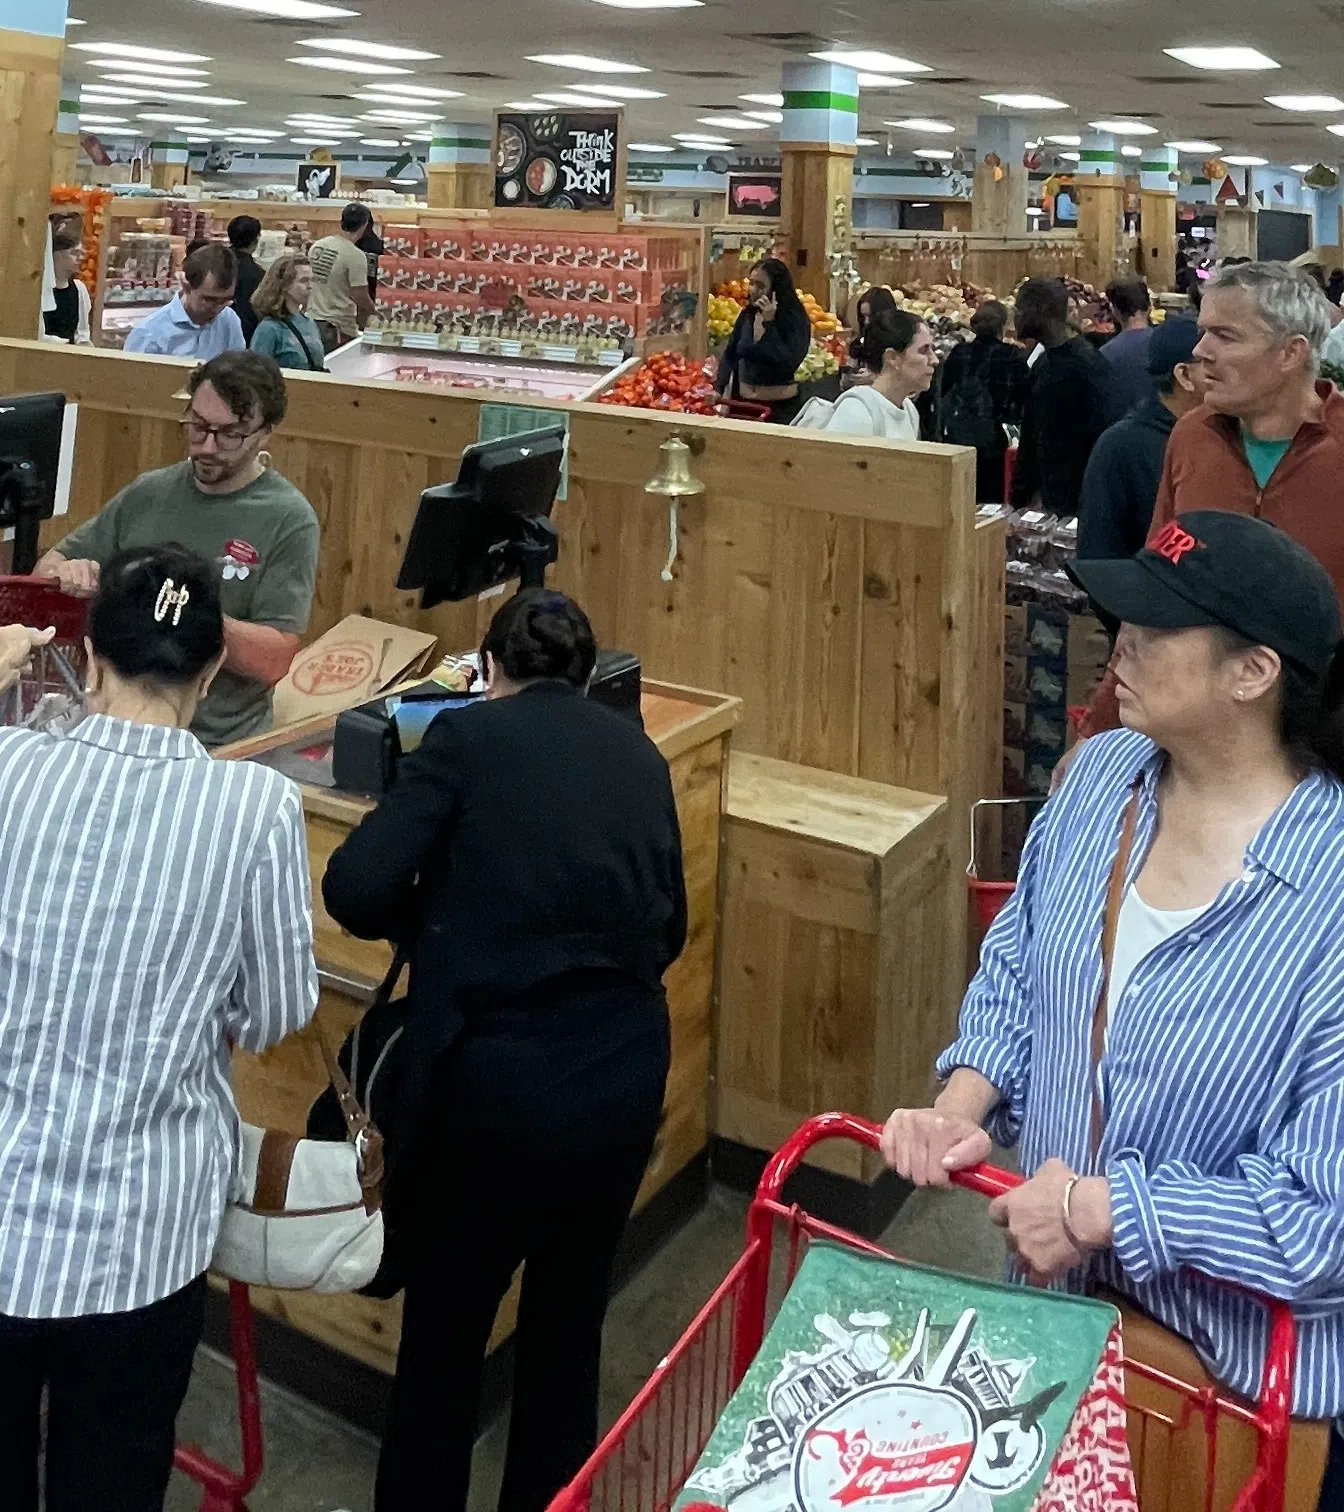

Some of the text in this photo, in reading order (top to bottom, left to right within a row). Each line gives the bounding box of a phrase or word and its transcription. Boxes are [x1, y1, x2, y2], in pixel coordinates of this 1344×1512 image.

[559, 164, 611, 195] DORM
[874, 1430, 951, 1453] COUNTING
[854, 1453, 962, 1492] Twenty
